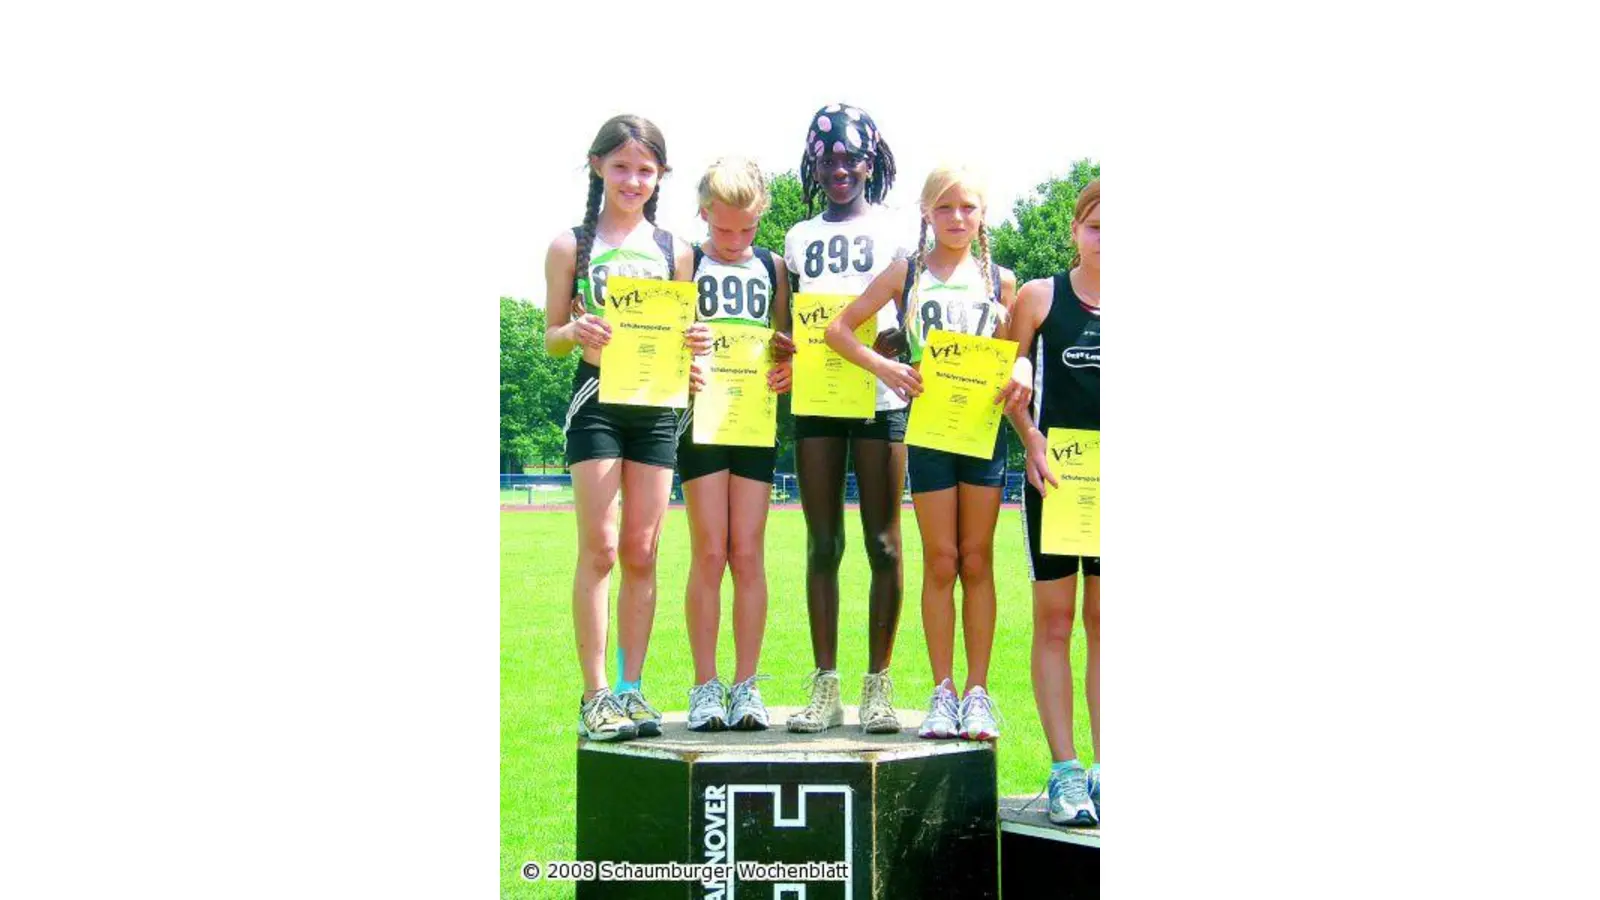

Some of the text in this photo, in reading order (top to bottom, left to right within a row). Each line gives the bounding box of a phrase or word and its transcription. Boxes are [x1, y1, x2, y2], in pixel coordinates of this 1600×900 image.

[804, 234, 874, 279] 893
[610, 289, 644, 309] VfL
[697, 274, 767, 319] 896
[798, 306, 830, 325] VfL
[712, 335, 730, 352] fL
[929, 342, 962, 359] VfL
[1051, 441, 1083, 461] VfL
